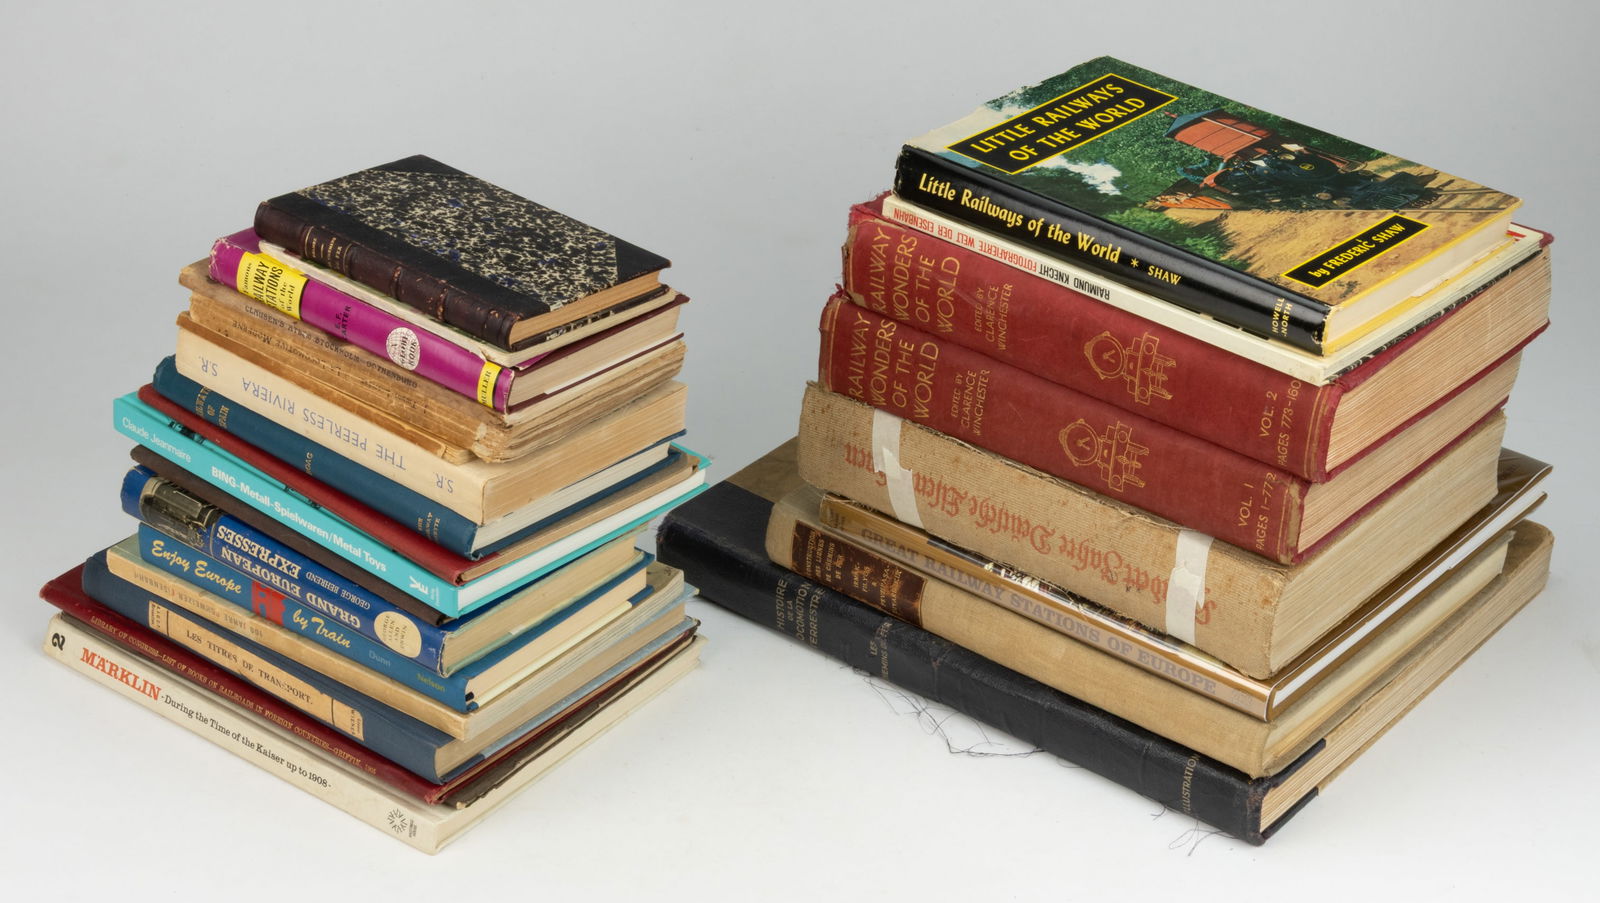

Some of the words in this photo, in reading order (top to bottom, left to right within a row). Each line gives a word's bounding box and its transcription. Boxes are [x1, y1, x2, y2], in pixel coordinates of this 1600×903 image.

[970, 123, 1036, 153] LITTLE
[1031, 83, 1125, 127] RAILWAYS
[1009, 145, 1038, 161] OF
[1036, 127, 1082, 149] THE
[1075, 97, 1146, 130] WORLD
[893, 207, 934, 233] EISENBAHN
[918, 172, 957, 201] Little
[961, 188, 1024, 228] Railways
[1027, 218, 1045, 237] of
[1047, 223, 1072, 245] the
[1077, 231, 1122, 264] World
[1147, 265, 1182, 286] SHAW
[938, 225, 953, 239] DER
[956, 232, 975, 247] WELT
[978, 241, 1037, 272] FOTOGRAFIERTE
[1308, 268, 1331, 279] by
[1372, 223, 1406, 243] SHAW
[870, 227, 892, 314] RAILWAY
[892, 234, 918, 321] WONDERS
[915, 255, 936, 291] THE
[1038, 263, 1069, 283] KNECHT
[1073, 277, 1110, 300] RAIMUND
[286, 285, 296, 311] World
[915, 297, 931, 323] OF
[936, 256, 961, 333] WORLD
[976, 287, 985, 300] BY
[336, 311, 342, 320] F.
[974, 302, 983, 332] EDITED
[986, 285, 999, 343] CLARENCE
[998, 283, 1013, 350] WINCHESTER
[1272, 298, 1284, 334] HOWELL
[198, 355, 218, 377] S.R.
[848, 312, 871, 399] RAILWAY
[870, 319, 897, 406] WONDERS
[896, 339, 915, 374] THE
[242, 377, 295, 415] RIVIERA
[892, 381, 908, 408] OF
[913, 342, 939, 418] WORLD
[955, 374, 964, 385] BY
[1266, 390, 1278, 401] 2
[951, 388, 961, 418] EDITED
[961, 370, 977, 429] CLARENCE
[973, 369, 991, 436] WINCHESTER
[303, 408, 367, 451] PEERLESS
[1259, 406, 1274, 438] VOL.
[376, 443, 407, 471] THE
[1278, 433, 1290, 466] PAGES
[122, 416, 149, 440] Claude
[363, 550, 388, 573] Toys
[1238, 495, 1253, 527] VOL.
[1256, 514, 1269, 550] PAGES
[216, 525, 302, 580] EXPRESSES
[221, 546, 302, 599] EUROPEAN
[305, 571, 340, 594] BEHREND
[151, 540, 191, 572] Enjoy
[194, 560, 242, 594] Europe
[293, 609, 309, 630] by
[311, 616, 351, 648] Train
[368, 651, 391, 667] Dunn
[416, 673, 445, 692] Nelson
[306, 592, 360, 629] GRAND
[340, 589, 371, 611] GEORGE
[776, 579, 788, 630] HISTOIRE
[861, 528, 919, 565] GREAT
[924, 555, 1006, 599] RAILWAY
[1010, 594, 1100, 643] STATIONS
[1107, 636, 1133, 656] OF
[1137, 650, 1217, 695] EUROPE
[51, 632, 66, 651] 2
[187, 629, 202, 644] LES
[207, 641, 237, 662] TITRES
[242, 660, 254, 673] DE
[90, 615, 118, 637] LIBRARY
[118, 630, 128, 640] OF
[177, 662, 187, 672] OF
[187, 666, 208, 682] BOOKS
[208, 679, 219, 689] ON
[219, 685, 254, 709] RAILROADS
[255, 704, 264, 714] IN
[264, 709, 294, 729] FOREIGN
[80, 647, 162, 701] MÄRKLIN
[194, 713, 209, 725] the
[210, 718, 230, 737] Time
[231, 732, 242, 742] of
[241, 736, 256, 749] the
[255, 743, 285, 765] Kaiser
[286, 761, 297, 773] up
[298, 767, 308, 777] to
